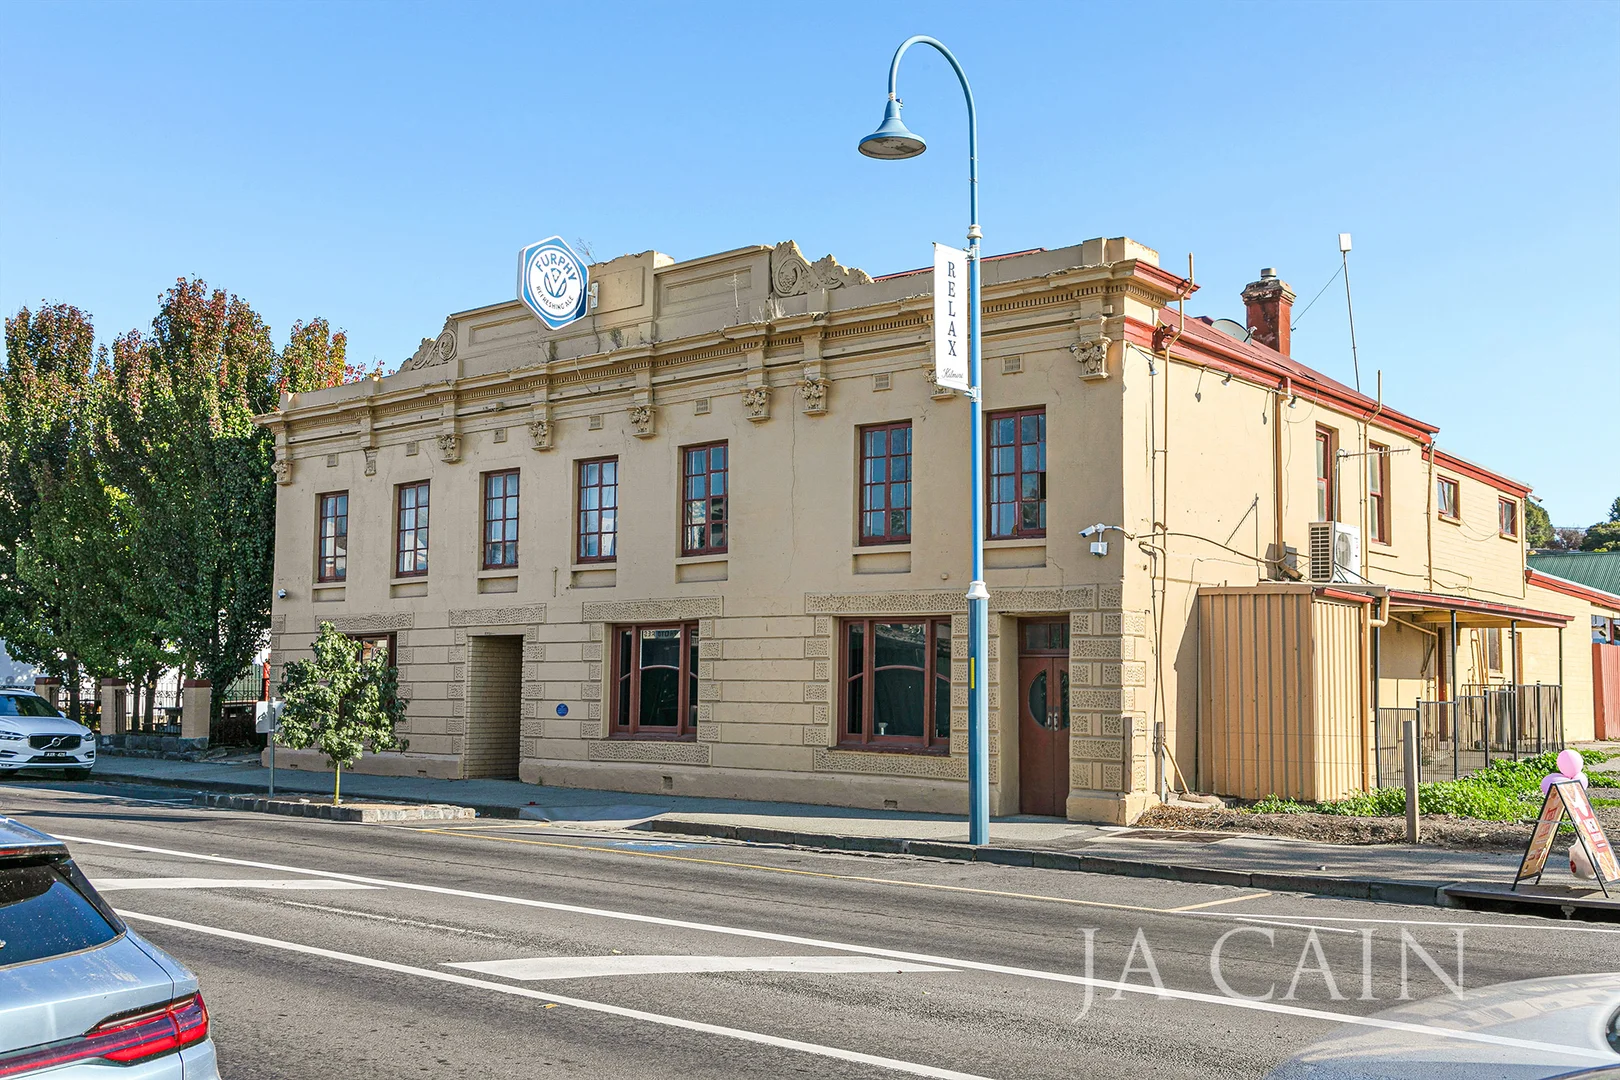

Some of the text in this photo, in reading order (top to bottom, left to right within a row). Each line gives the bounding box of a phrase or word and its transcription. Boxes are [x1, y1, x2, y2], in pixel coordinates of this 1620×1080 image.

[535, 253, 577, 281] FURPHY
[565, 295, 574, 307] ALE
[947, 261, 957, 357] RELAX
